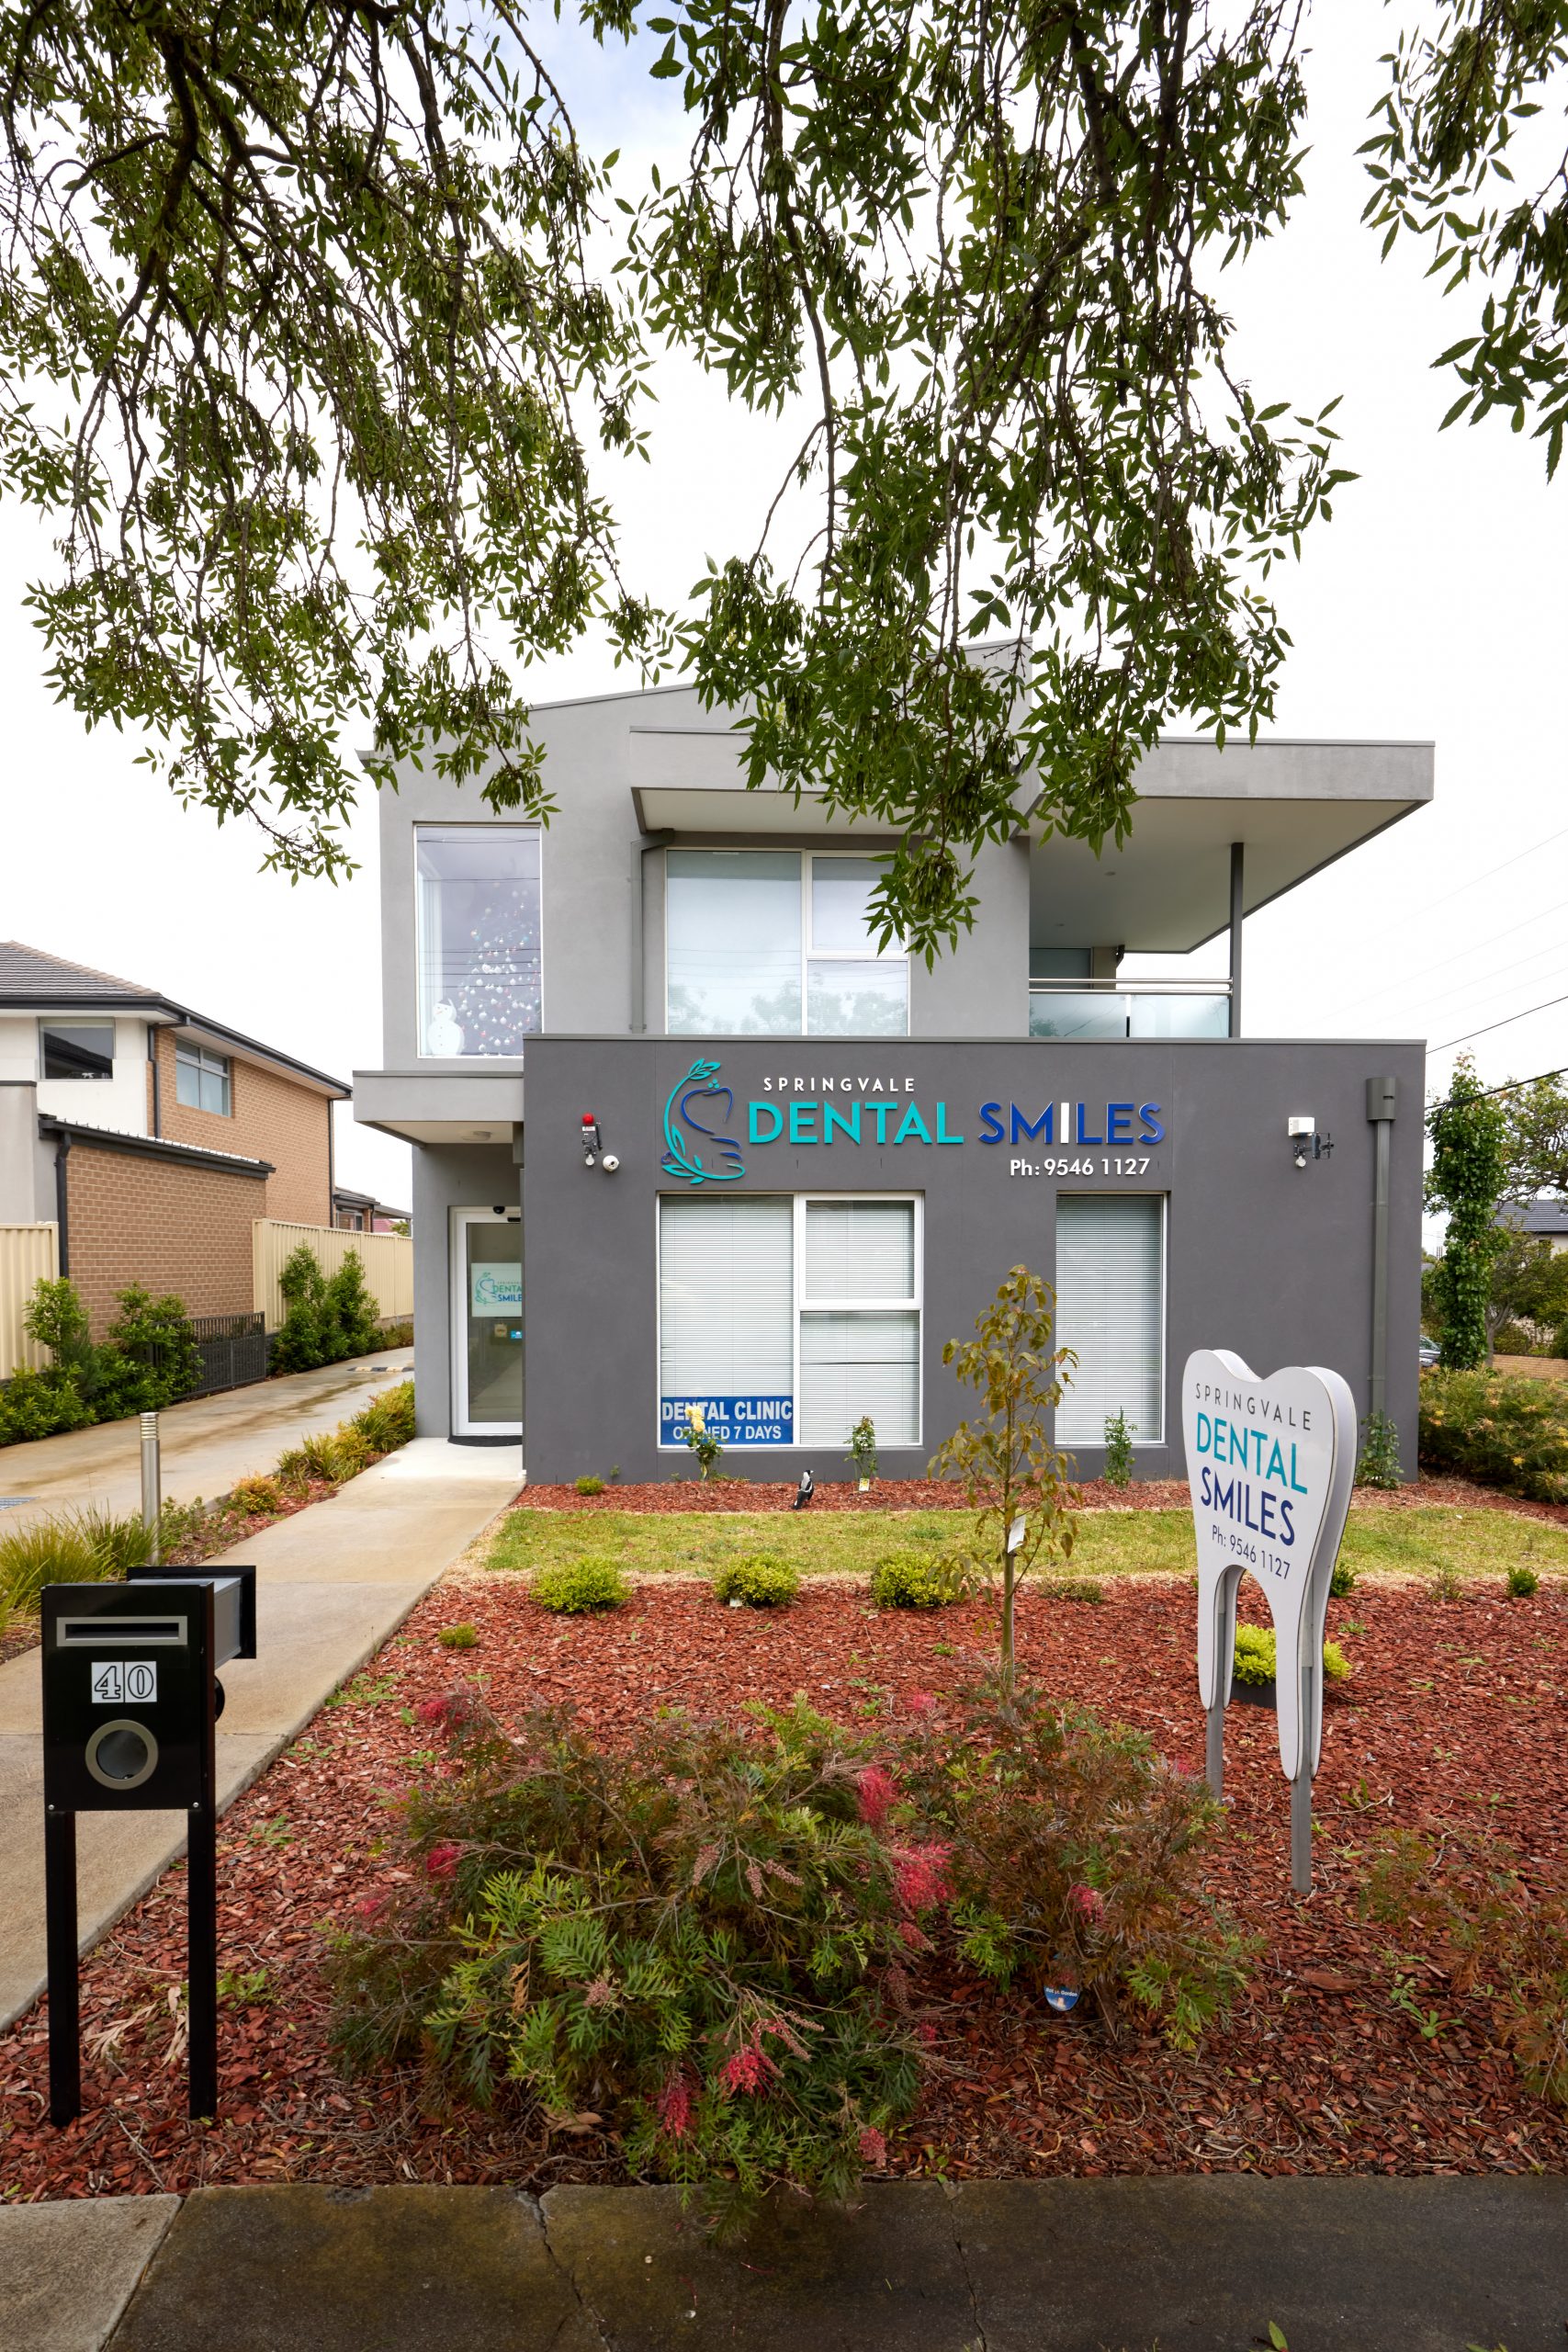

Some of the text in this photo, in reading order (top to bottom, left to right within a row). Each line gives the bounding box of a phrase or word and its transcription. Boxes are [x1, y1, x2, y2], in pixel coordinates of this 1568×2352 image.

[763, 1077, 915, 1091] SPRINGVALE
[749, 1101, 1166, 1145] DENTAL SMILES
[1010, 1158, 1150, 1176] Ph: 9546 1127
[734, 1400, 793, 1420] CLINIC
[1195, 1383, 1311, 1431] SPRINGVALE
[734, 1426, 741, 1439] 7
[745, 1425, 782, 1440] DAYS
[1197, 1411, 1308, 1495] DENTAL
[1201, 1466, 1295, 1546] SMILES
[1213, 1524, 1291, 1579] Ph: 9546 1127
[94, 1665, 154, 1700] 40
